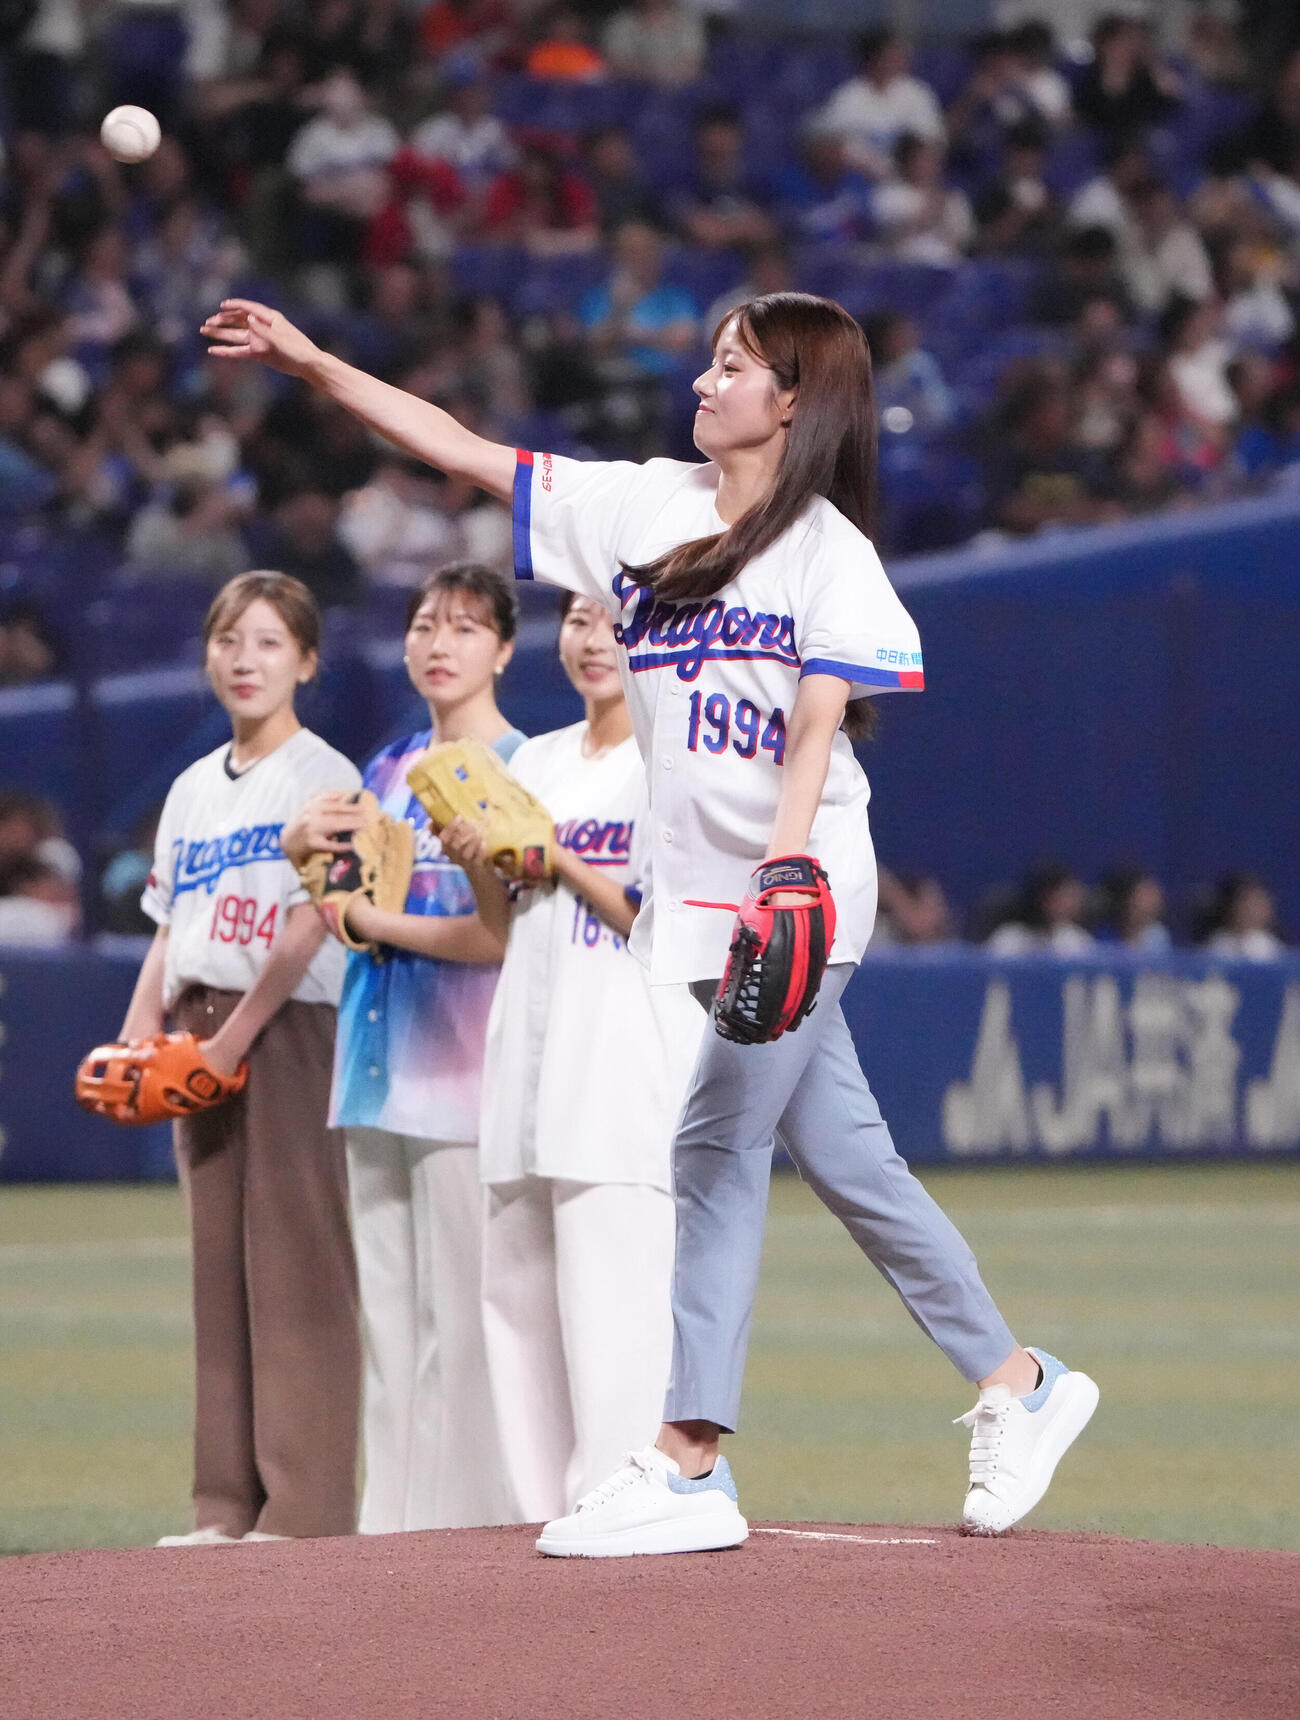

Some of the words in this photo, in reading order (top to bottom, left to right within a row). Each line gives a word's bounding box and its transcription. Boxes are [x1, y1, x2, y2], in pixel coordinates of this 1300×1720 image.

[612, 572, 800, 682] Dragons
[687, 690, 787, 766] 1994
[763, 871, 803, 885] IGNIO
[210, 895, 279, 949] 1994
